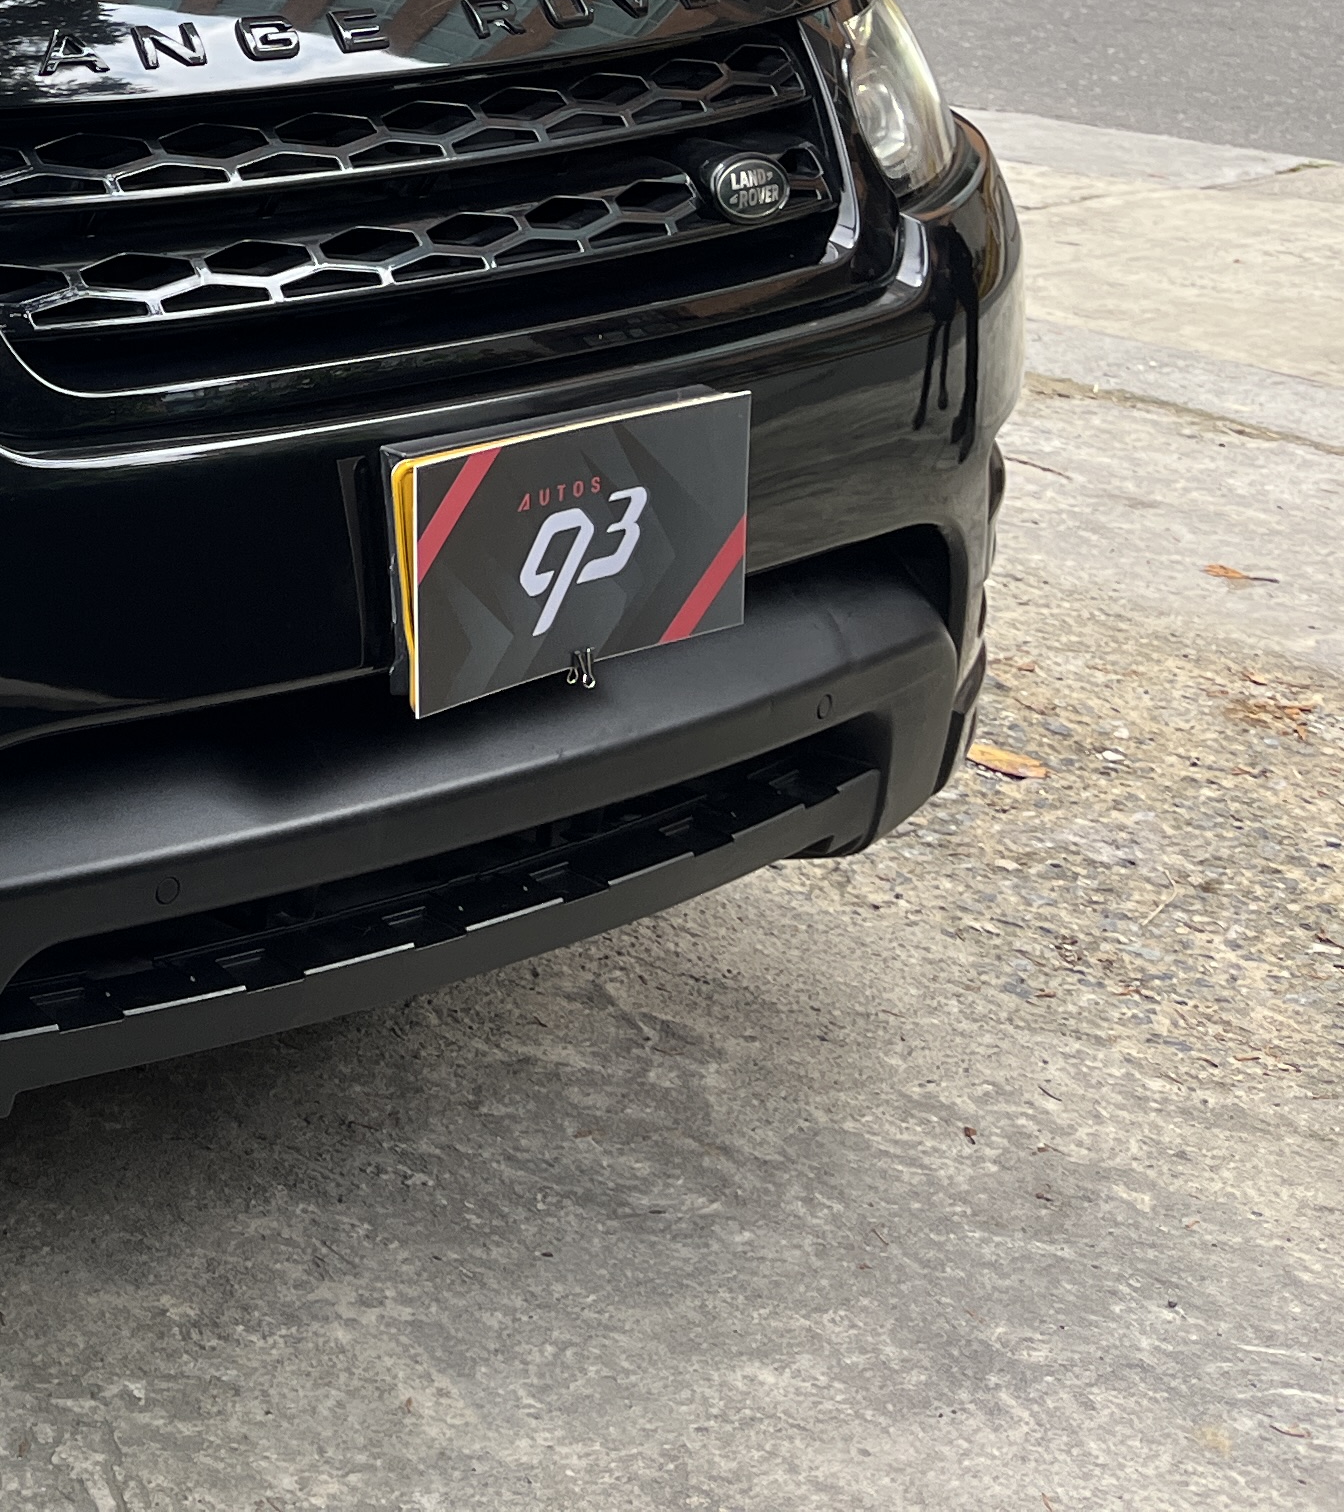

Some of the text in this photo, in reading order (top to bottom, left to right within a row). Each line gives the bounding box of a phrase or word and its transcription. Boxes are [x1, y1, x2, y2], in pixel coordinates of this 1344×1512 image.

[730, 168, 767, 191] LAND
[738, 183, 779, 209] ROVER
[517, 476, 602, 512] AUTOS
[519, 486, 648, 637] 93
